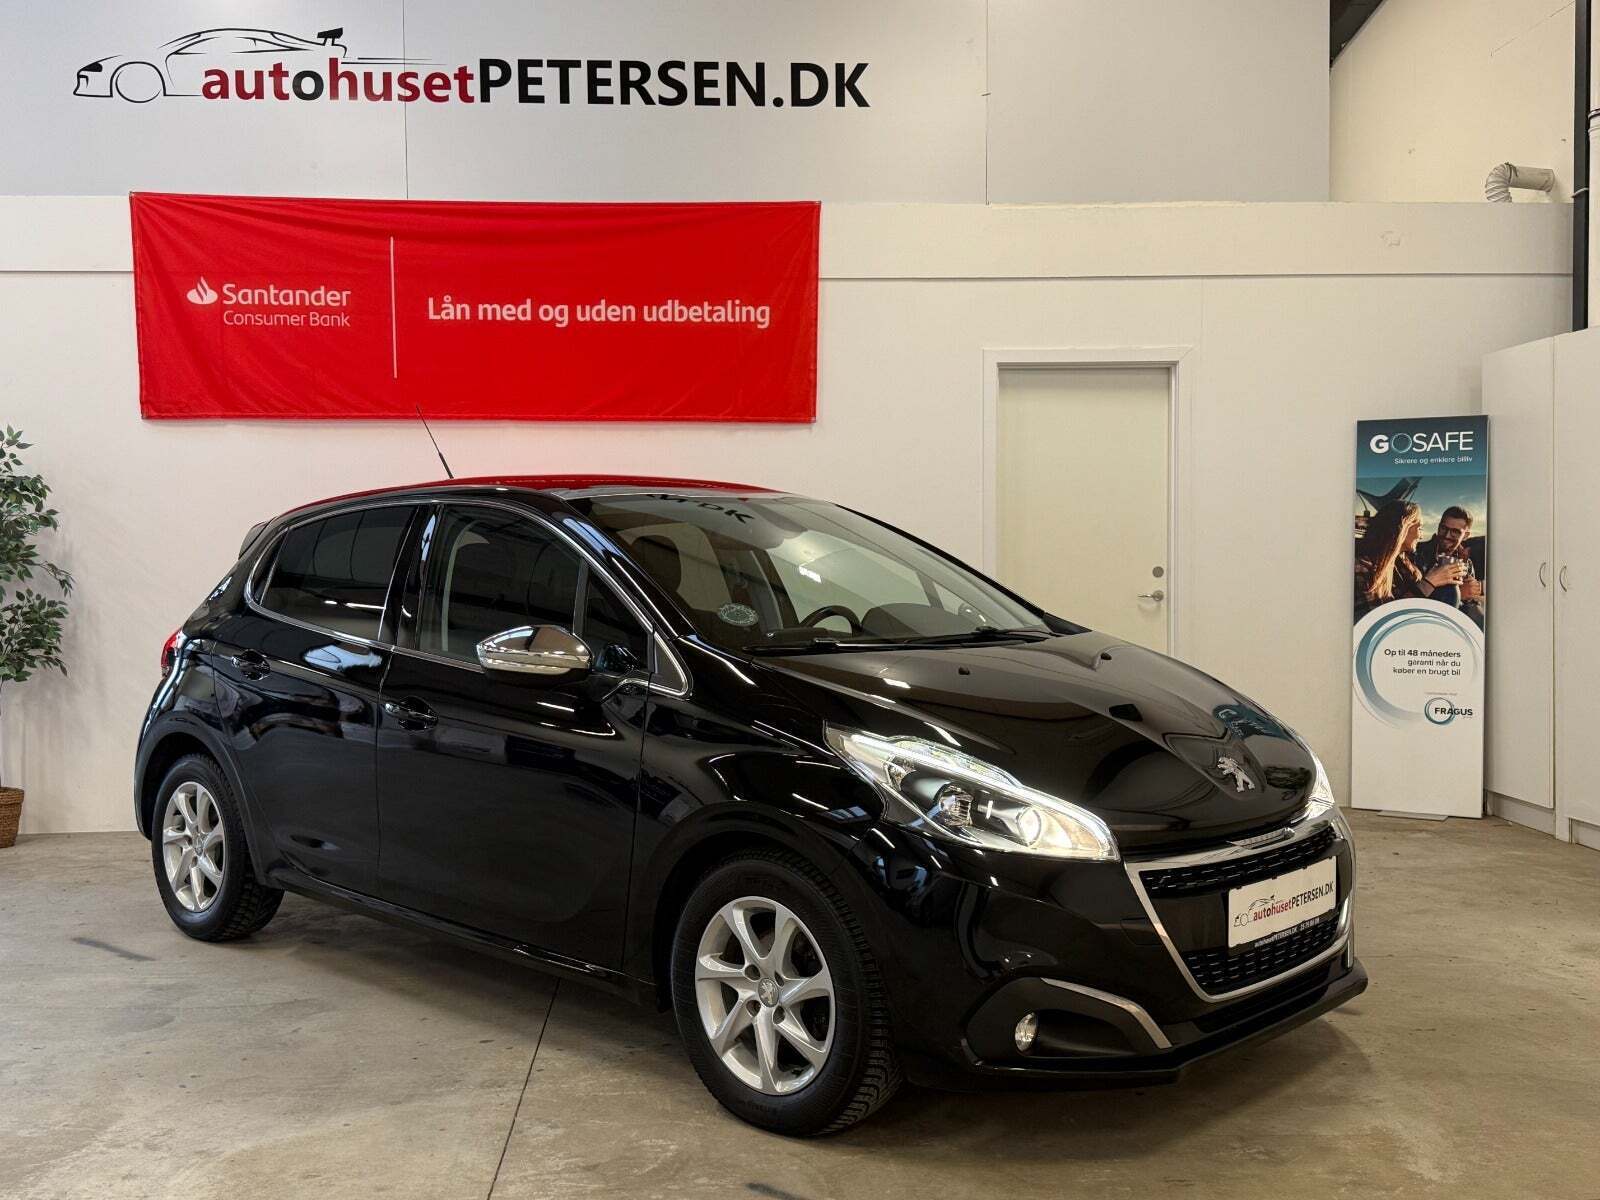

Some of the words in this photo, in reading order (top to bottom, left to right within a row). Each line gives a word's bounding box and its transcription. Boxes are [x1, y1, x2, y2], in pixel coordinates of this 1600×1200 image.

[201, 57, 871, 107] autohusetPETERSEN.DK
[222, 283, 351, 306] Santander
[223, 310, 305, 326] Consumer
[309, 311, 350, 327] Bank
[428, 295, 470, 320] Lån
[478, 298, 532, 321] med
[538, 307, 568, 327] og
[576, 299, 636, 322] uden
[643, 299, 770, 328] udbetaling
[1370, 431, 1474, 454] GOSAFE
[1384, 648, 1397, 657] Op
[1398, 649, 1406, 657] til
[1407, 649, 1418, 657] 48
[1420, 649, 1461, 658] måneders
[1407, 659, 1434, 667] garanti
[1435, 659, 1449, 667] når
[1393, 667, 1415, 675] køber
[1428, 668, 1450, 676] brugt
[1451, 668, 1461, 676] bil
[1434, 707, 1473, 716] FRAGUS
[1253, 880, 1334, 921] autohusetPETERSEN.DK
